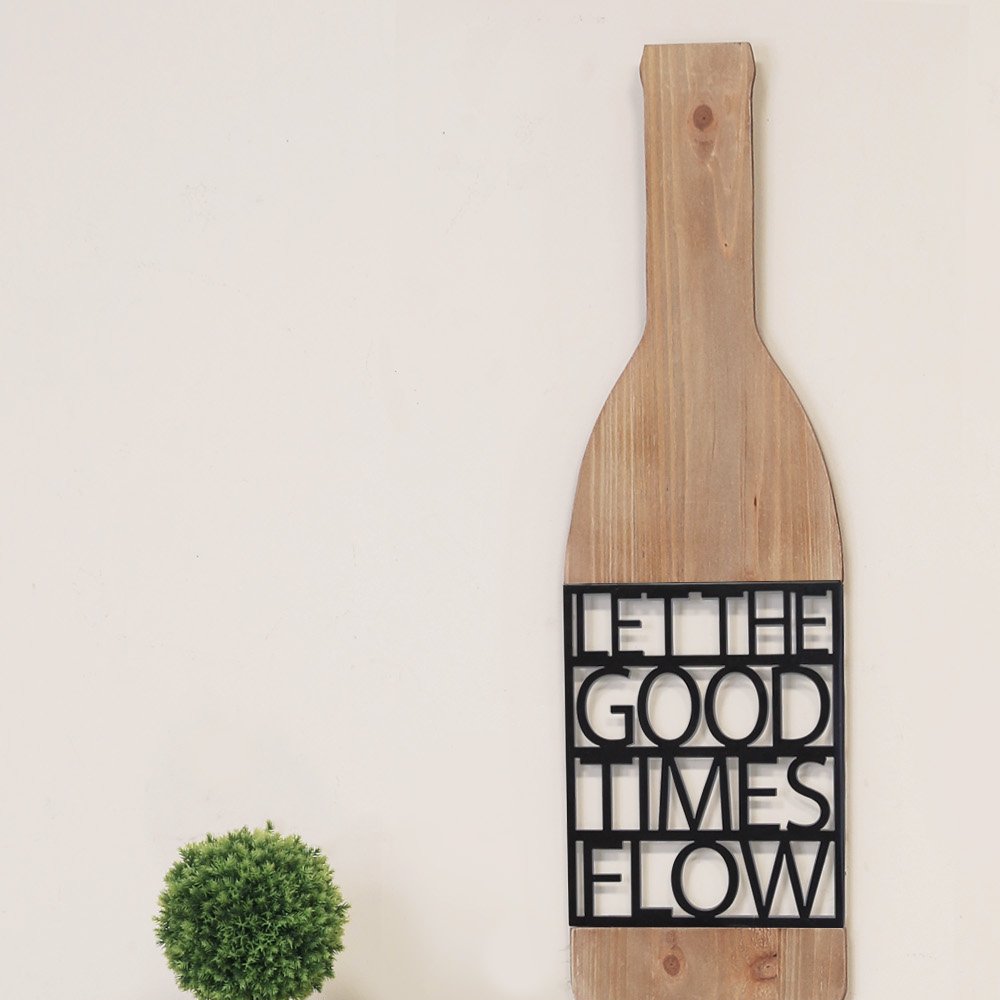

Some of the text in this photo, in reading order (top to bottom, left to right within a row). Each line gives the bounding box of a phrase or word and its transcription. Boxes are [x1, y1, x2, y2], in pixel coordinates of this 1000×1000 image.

[577, 591, 829, 657] LET THE
[577, 664, 830, 748] GOOD
[580, 757, 830, 831] TIMES
[583, 840, 831, 917] FLOW
